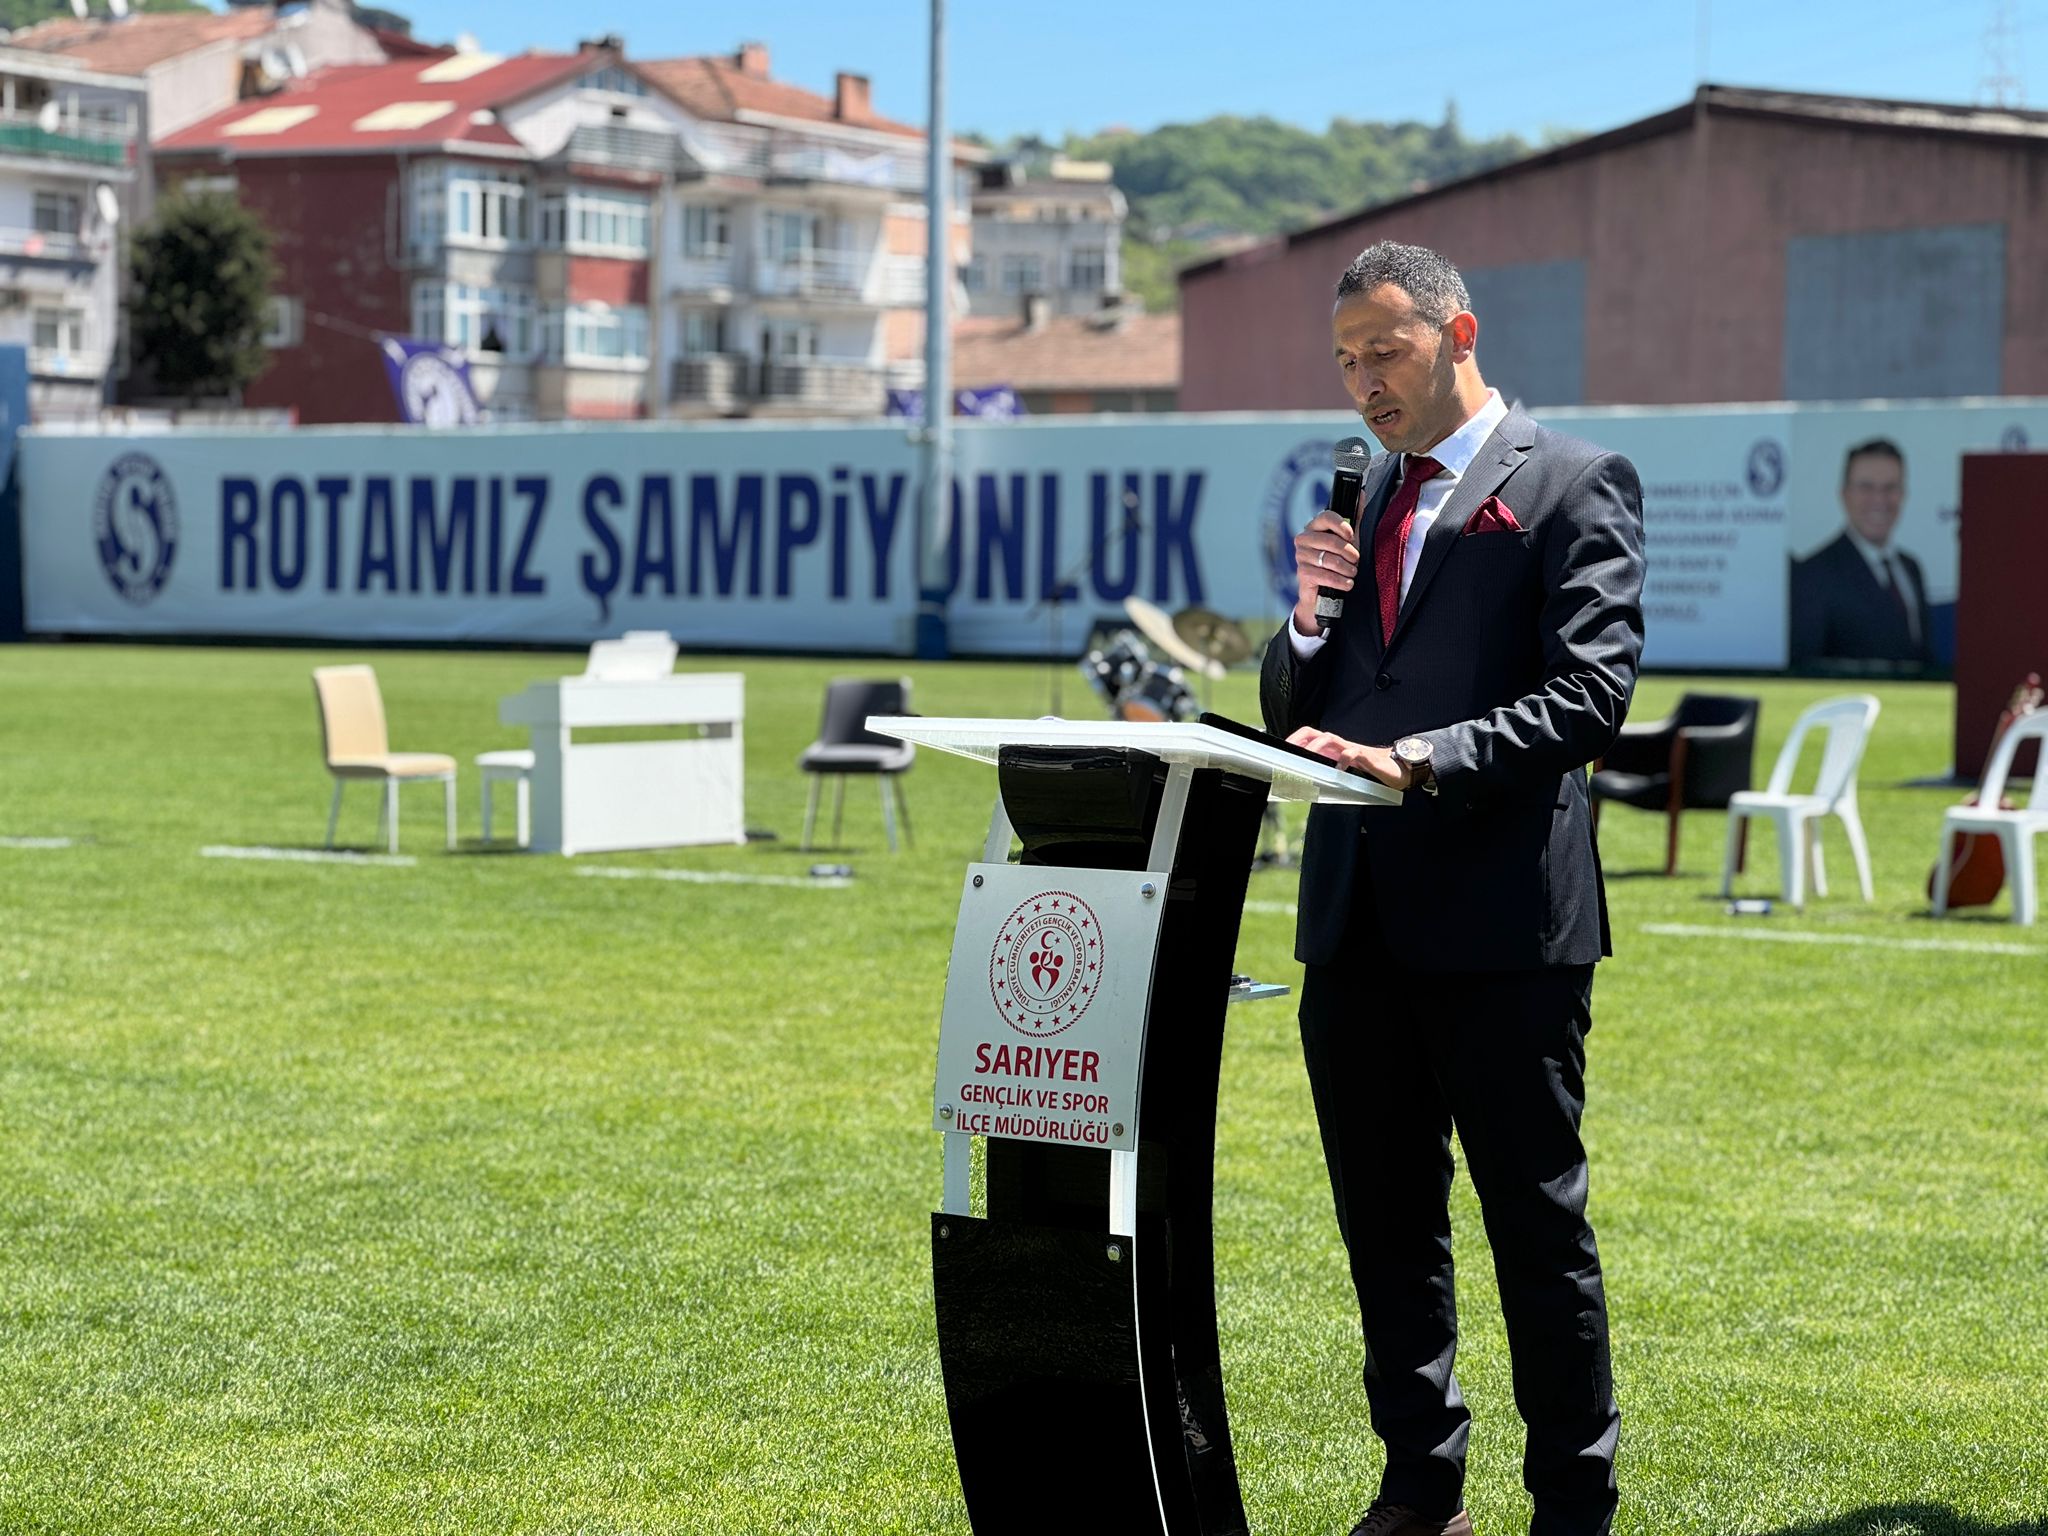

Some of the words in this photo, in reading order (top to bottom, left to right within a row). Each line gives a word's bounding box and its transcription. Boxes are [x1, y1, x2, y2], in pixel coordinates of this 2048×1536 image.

[220, 475, 550, 596] ROTAMIZ
[1042, 917, 1072, 932] GENÇLİK
[1070, 930, 1079, 940] VE
[1075, 941, 1083, 966] SPOR
[974, 1042, 1100, 1083] SARIYER
[960, 1083, 1033, 1110] GENÇLİK
[1036, 1089, 1058, 1110] VE
[1061, 1092, 1109, 1114] SPOR
[956, 1108, 991, 1136] İLÇE
[994, 1114, 1109, 1145] MÜDÜRLÜĞÜ
